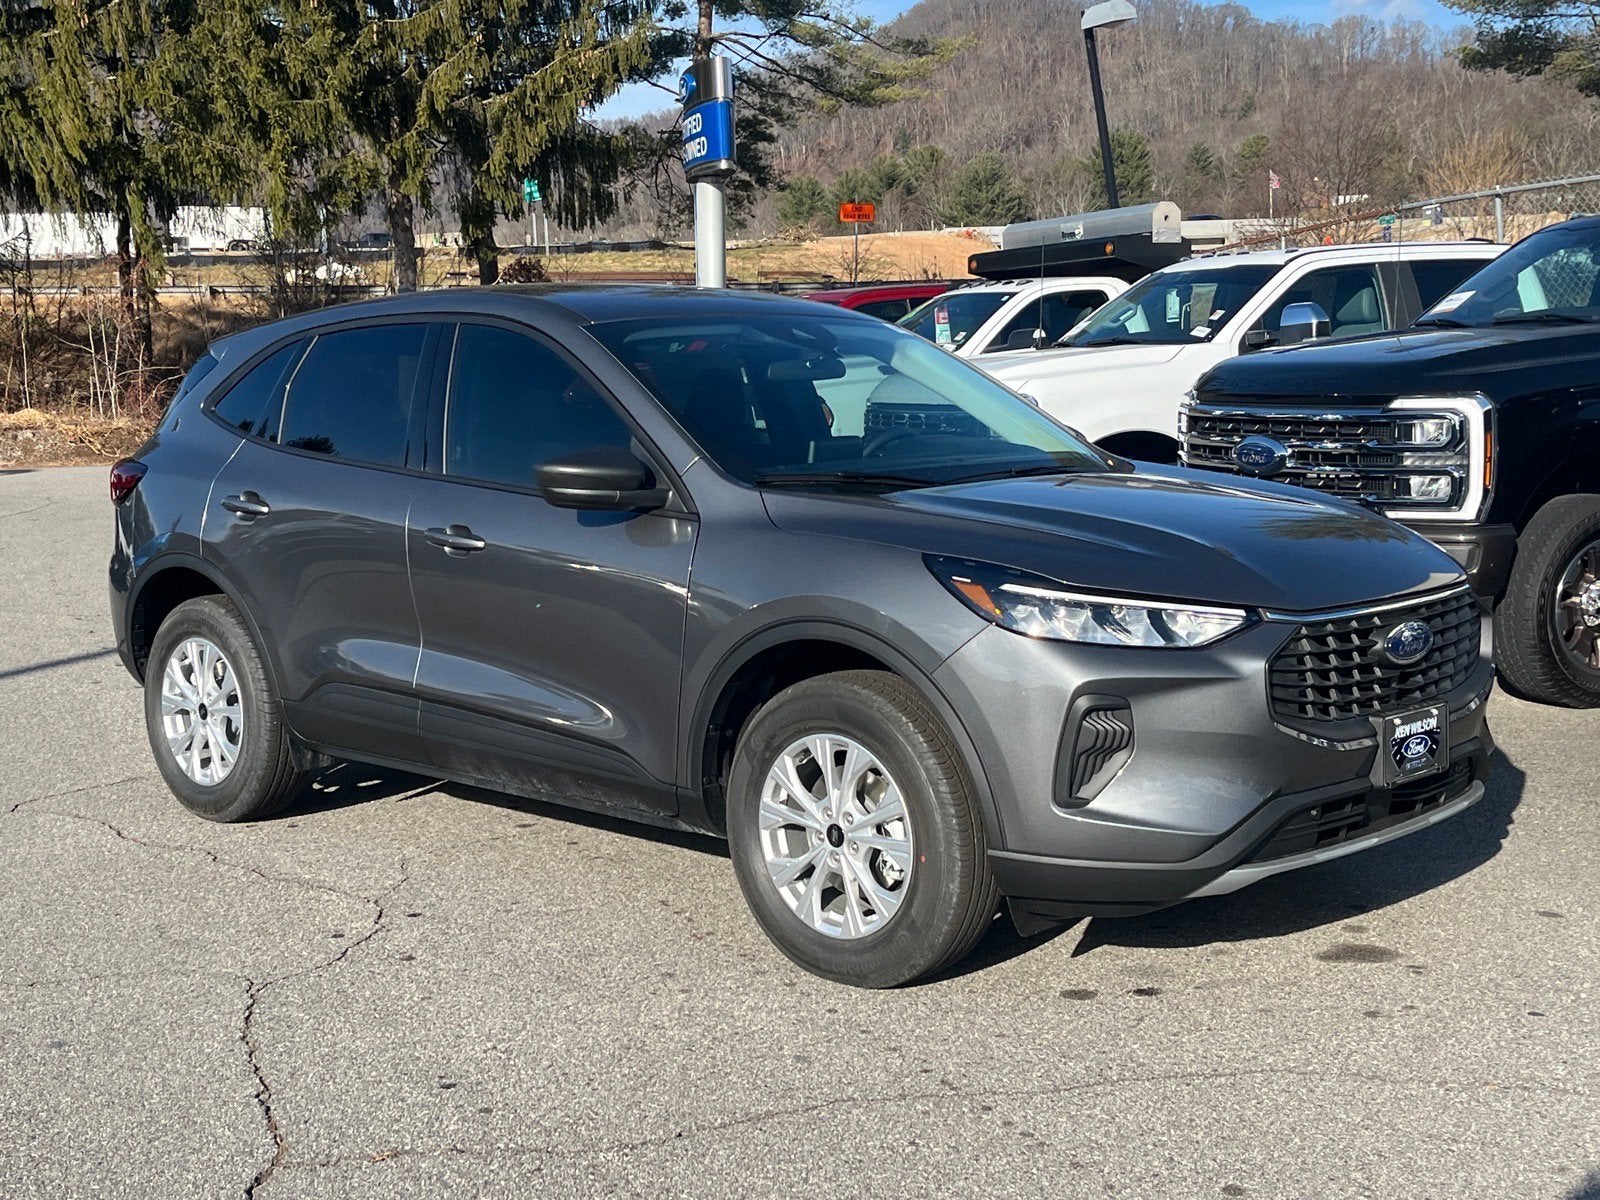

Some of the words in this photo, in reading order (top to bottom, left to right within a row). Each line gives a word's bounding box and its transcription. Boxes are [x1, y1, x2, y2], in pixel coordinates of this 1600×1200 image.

[1241, 446, 1267, 464] Ford
[1399, 629, 1425, 655] Ford
[1394, 724, 1410, 739] KEN
[1410, 716, 1438, 735] WILSON
[1407, 738, 1426, 755] Ford
